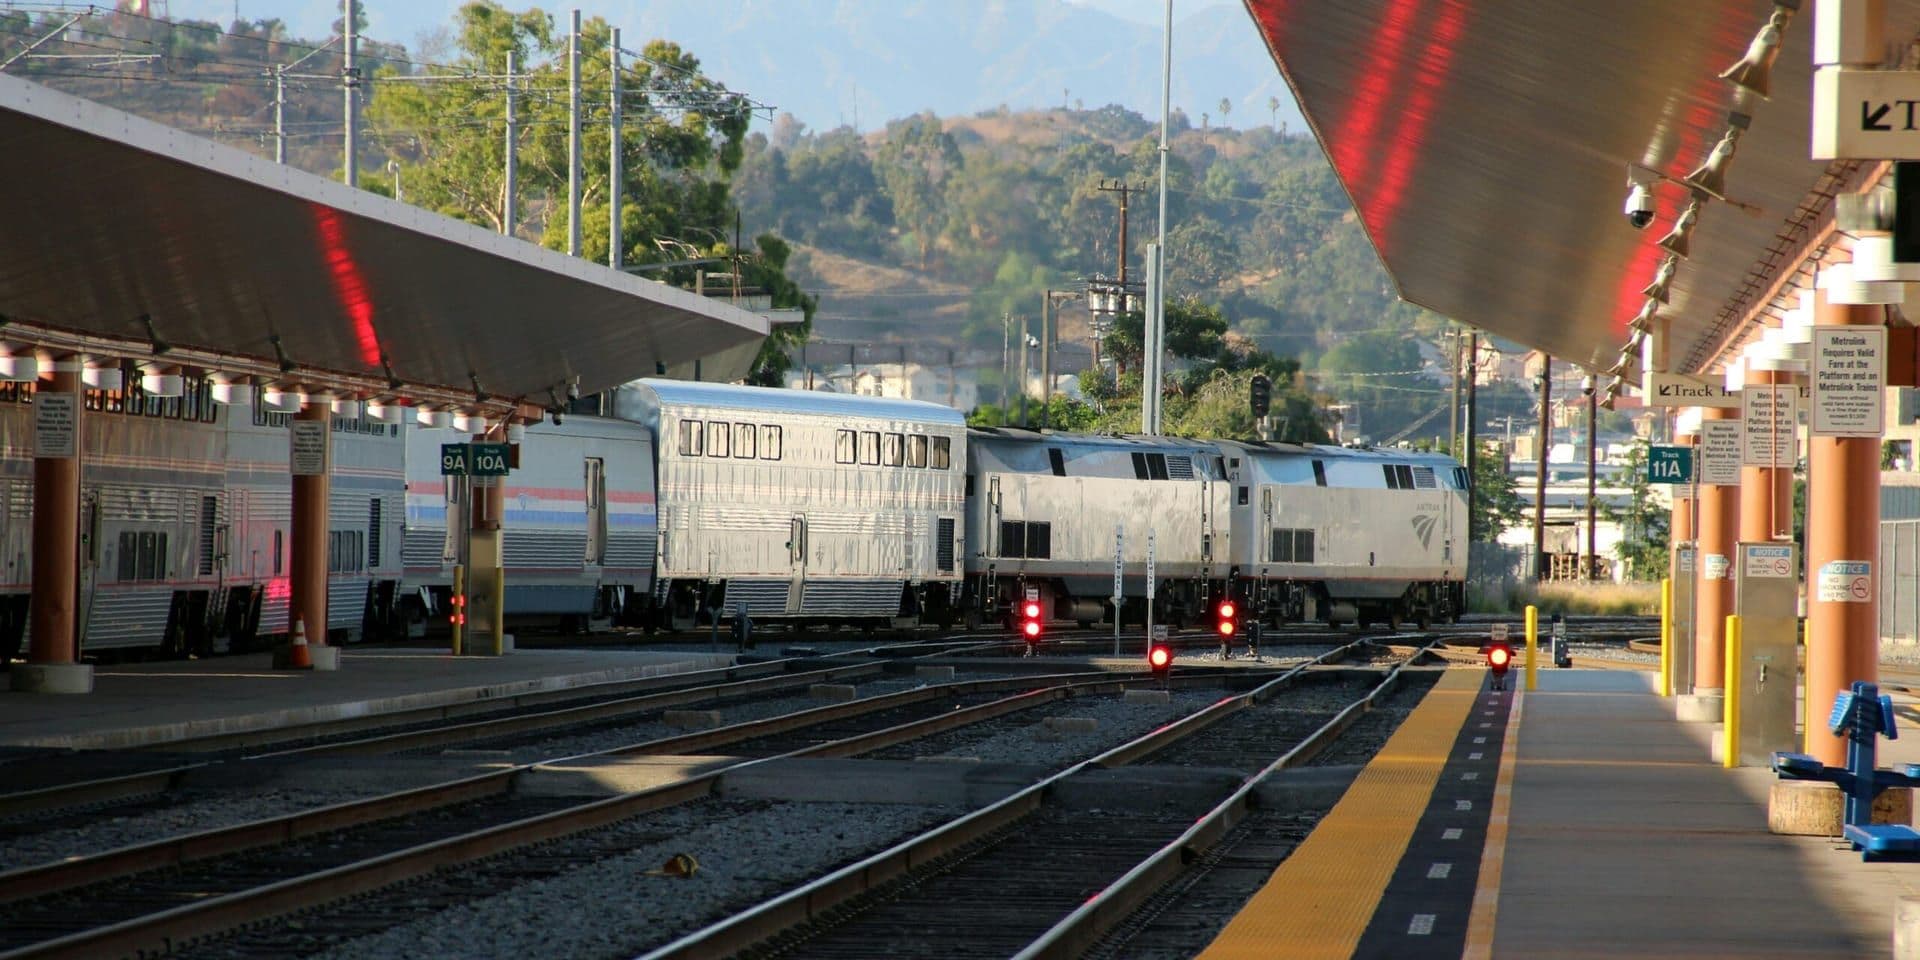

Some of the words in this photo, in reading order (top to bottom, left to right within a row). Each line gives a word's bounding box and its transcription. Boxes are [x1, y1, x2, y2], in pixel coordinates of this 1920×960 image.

[1831, 336, 1866, 345] Metrolink
[1823, 348, 1855, 358] Requires
[1856, 348, 1875, 357] Valid
[1829, 360, 1844, 368] Fare
[1847, 360, 1854, 368] at
[1856, 360, 1868, 368] the
[1819, 370, 1850, 380] Platform
[1853, 372, 1866, 380] and
[1672, 384, 1712, 396] Track
[1819, 382, 1854, 392] Metrolink
[1856, 382, 1878, 392] Trains
[1751, 400, 1772, 408] Require
[444, 456, 465, 470] 9A
[476, 456, 504, 470] 10A
[1653, 460, 1682, 478] 11A
[1755, 548, 1785, 556] NOTICE
